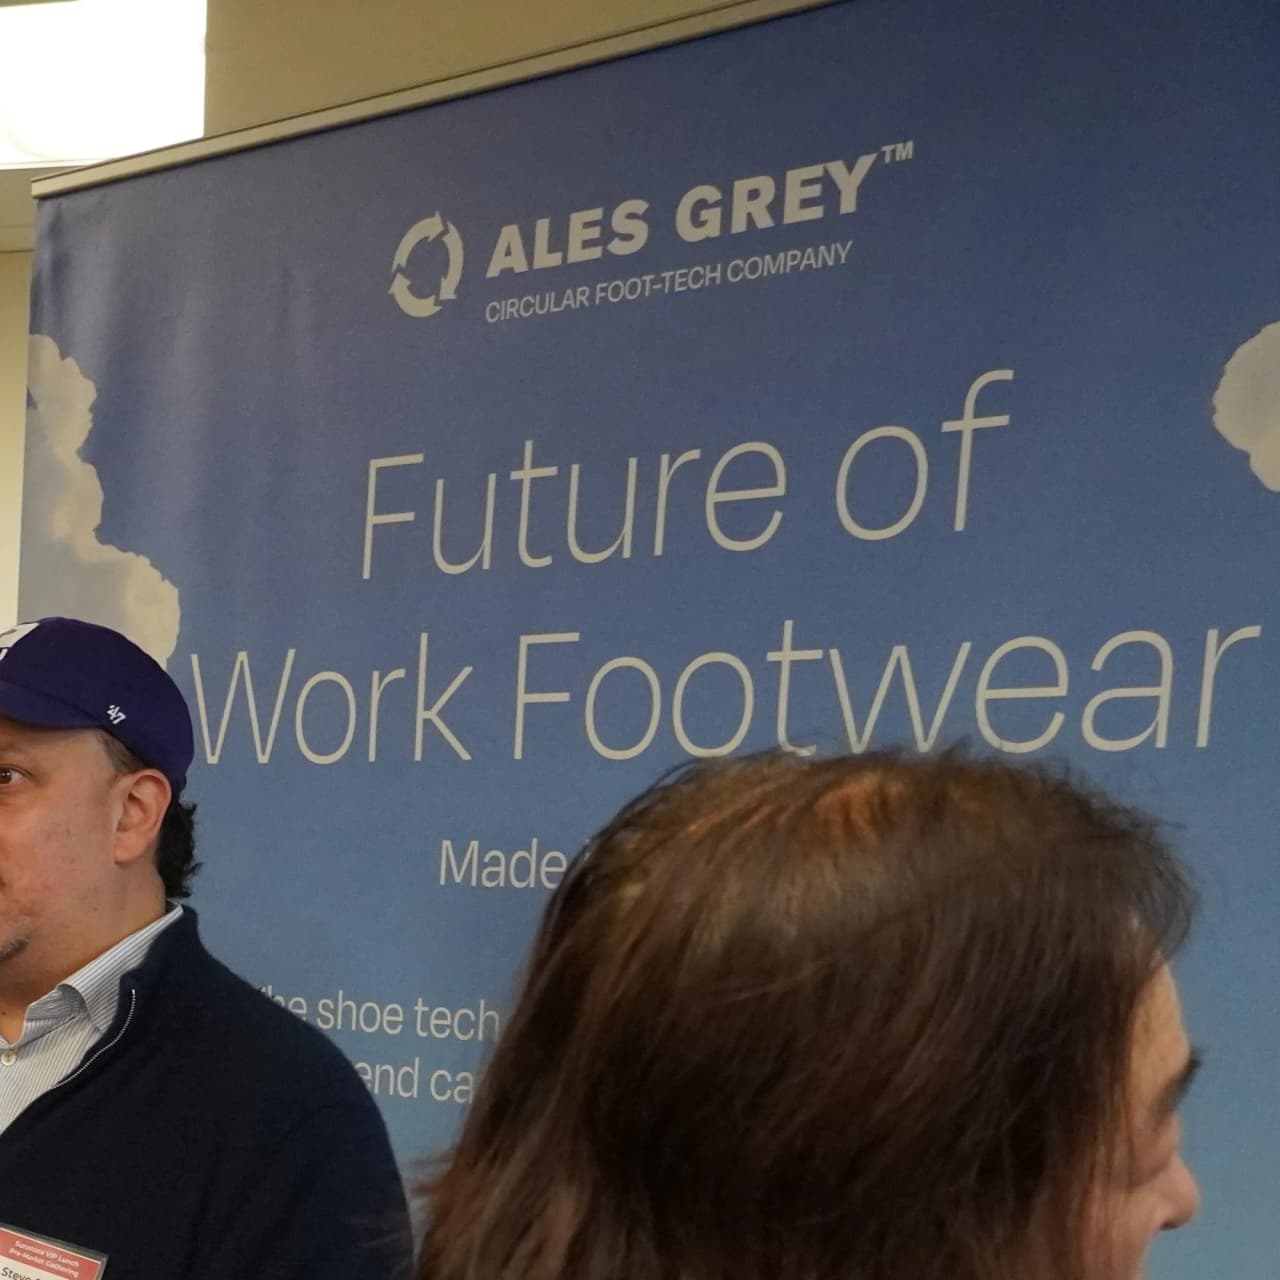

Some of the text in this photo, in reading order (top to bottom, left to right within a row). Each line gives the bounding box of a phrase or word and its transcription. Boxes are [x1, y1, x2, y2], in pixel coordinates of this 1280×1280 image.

[485, 199, 650, 278] ALES
[485, 240, 853, 323] CIRCULAR FOOT-TECH COMPANY
[361, 368, 1014, 580] Future of
[190, 618, 1262, 765] Work Footwear
[439, 837, 568, 889] Made
[316, 989, 404, 1035] shoe
[414, 997, 500, 1042] tech
[354, 1056, 474, 1104] end ca
